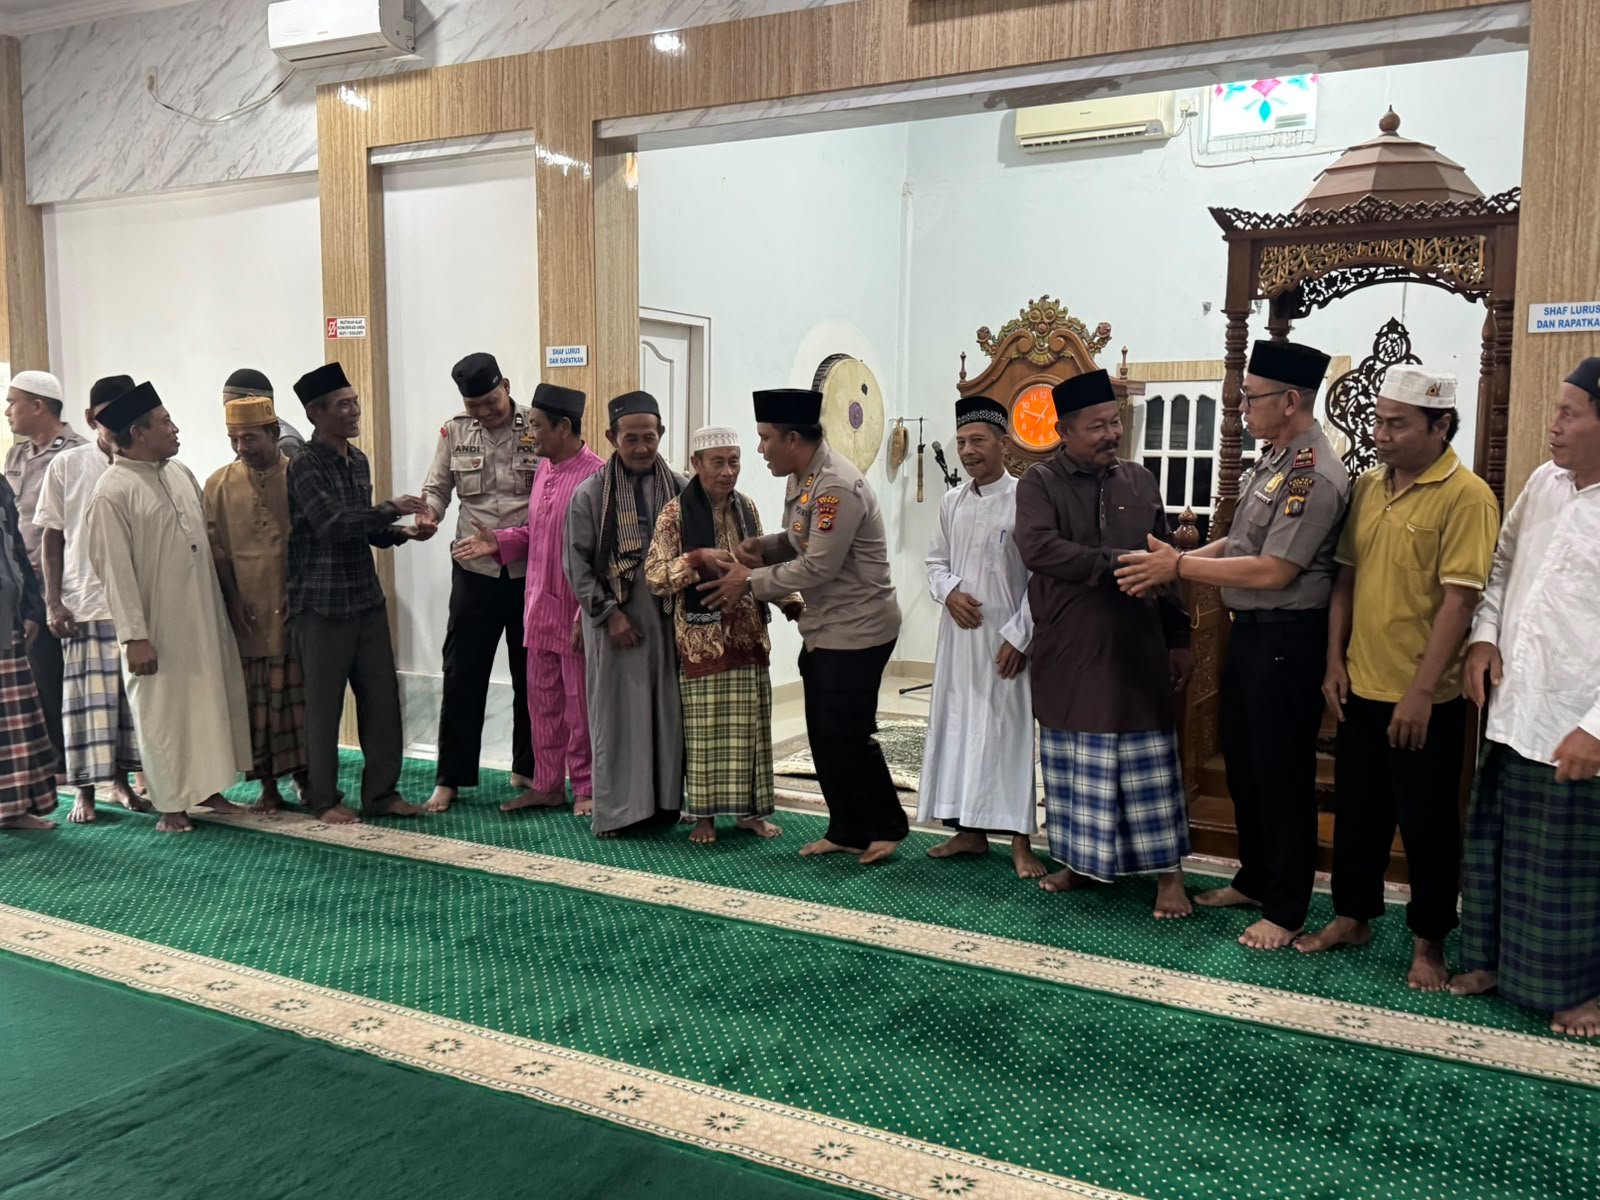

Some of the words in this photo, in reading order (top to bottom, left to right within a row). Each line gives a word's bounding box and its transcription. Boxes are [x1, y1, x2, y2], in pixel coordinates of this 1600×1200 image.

[1543, 306, 1568, 316] SHAF
[1570, 304, 1600, 315] LURUS
[1536, 319, 1556, 329] DAN
[1557, 317, 1600, 328] RAPATKA
[565, 347, 580, 355] LURUS
[559, 356, 584, 364] RAPATKAN
[455, 445, 480, 453] ANDI
[517, 445, 535, 453] POL
